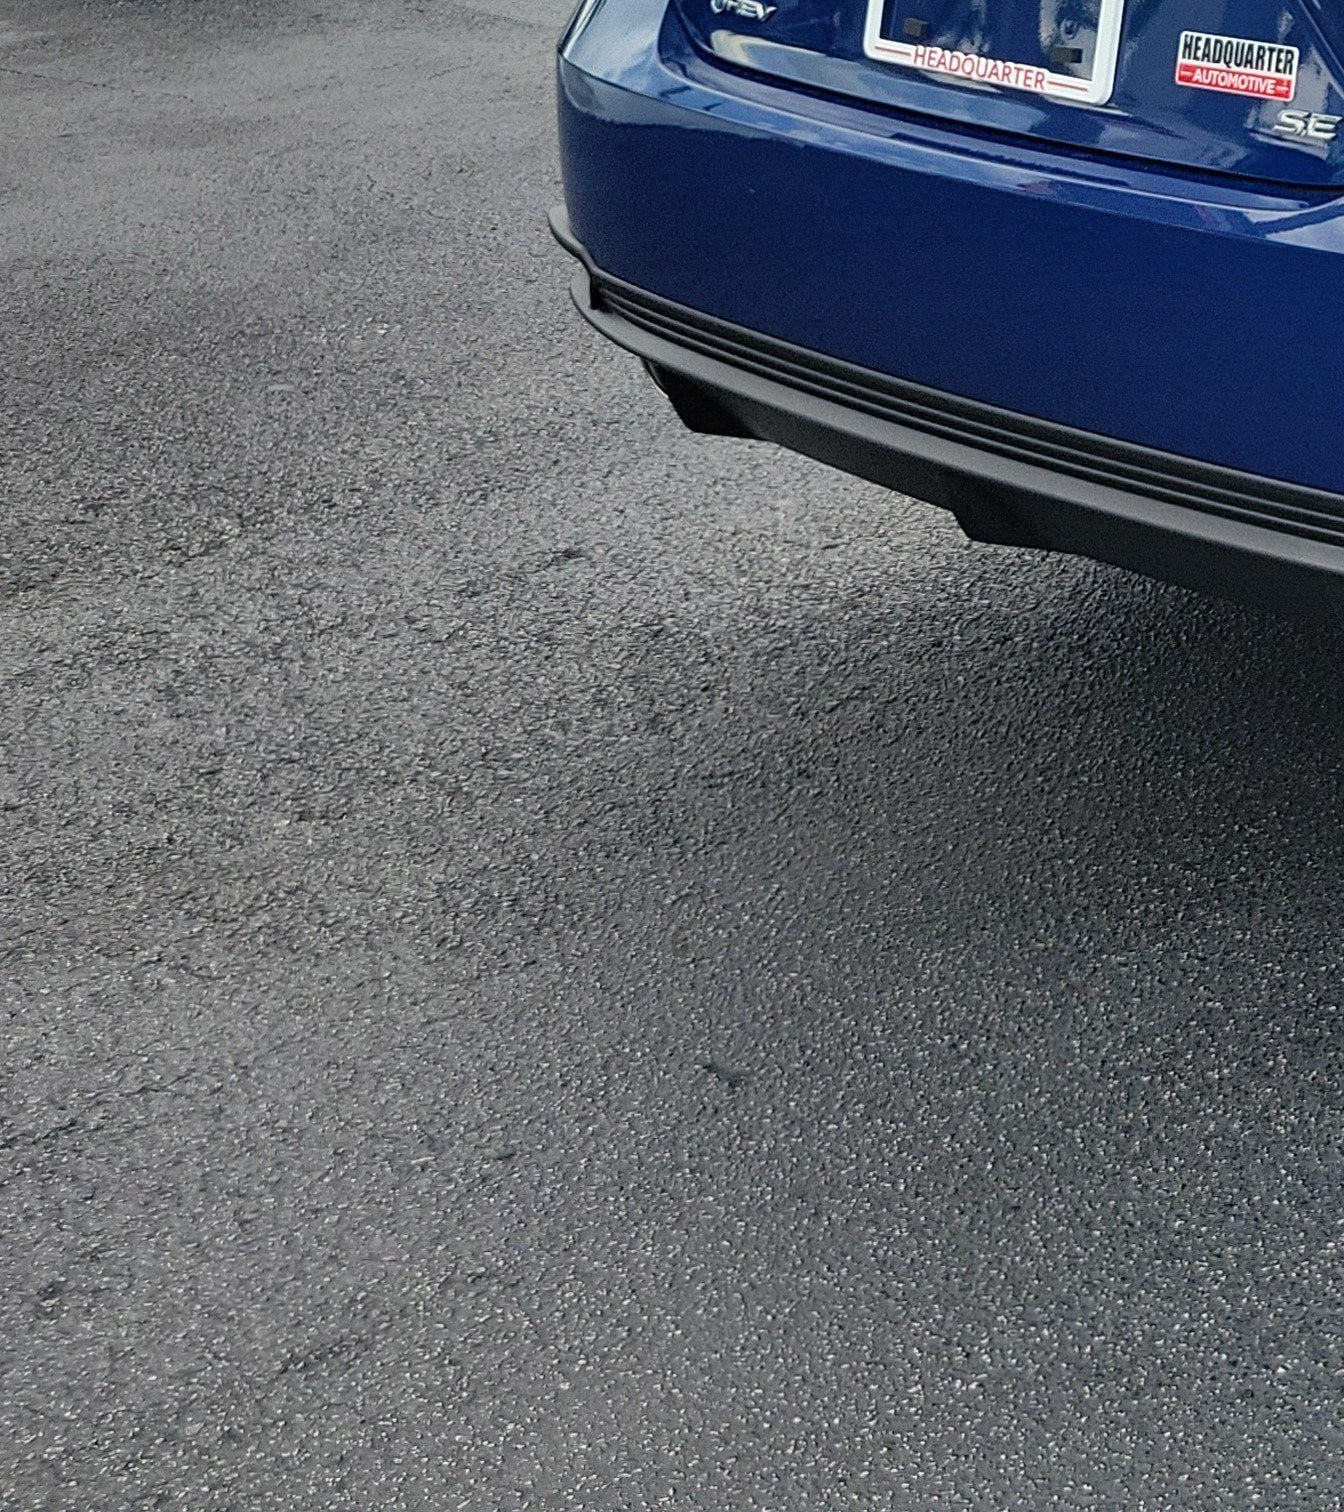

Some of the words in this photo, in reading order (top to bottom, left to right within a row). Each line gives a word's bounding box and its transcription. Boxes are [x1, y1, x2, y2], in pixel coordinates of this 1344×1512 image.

[913, 44, 1046, 90] HEADQUARTER
[1182, 33, 1295, 75] HEADQUARTER
[1192, 68, 1277, 94] AUTOMOTIVE
[1272, 108, 1344, 139] SE
